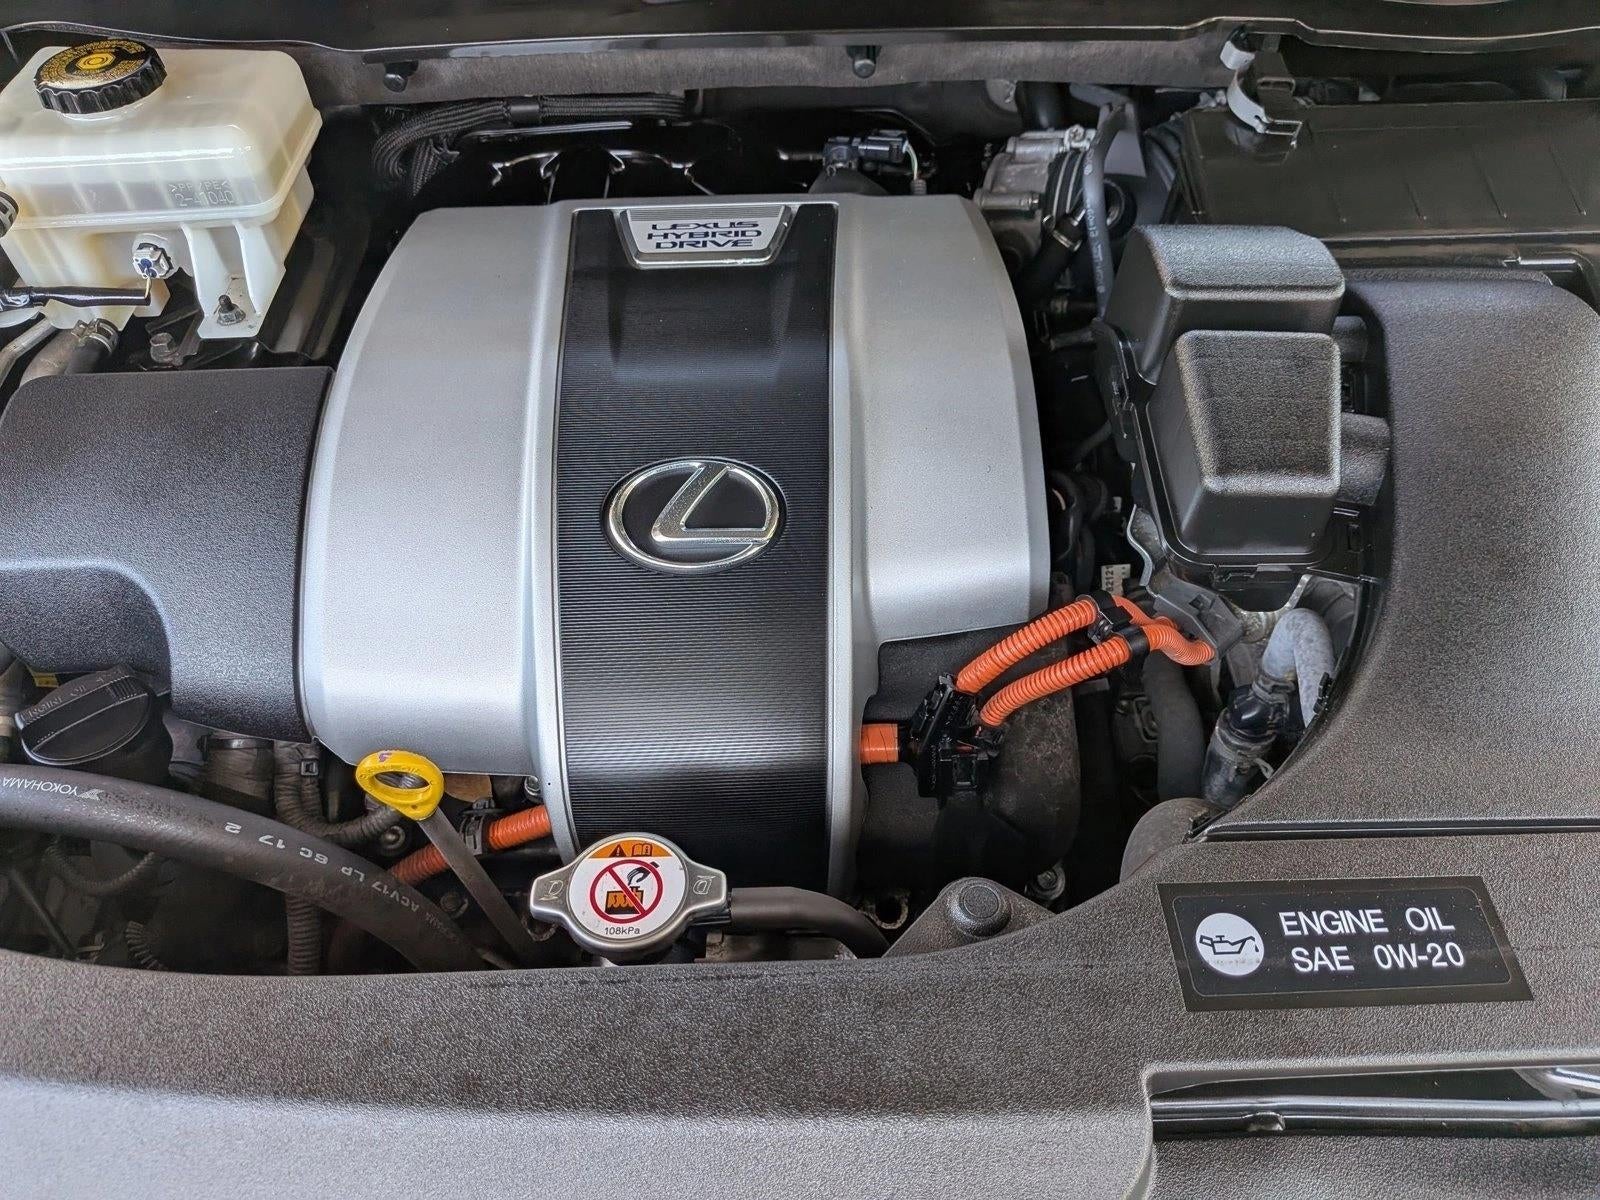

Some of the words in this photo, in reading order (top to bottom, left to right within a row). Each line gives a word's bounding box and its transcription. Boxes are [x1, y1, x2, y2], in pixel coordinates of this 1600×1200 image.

[652, 221, 759, 230] LEXUS
[647, 230, 762, 240] HYBRID
[655, 239, 753, 249] DRIVE
[2, 777, 79, 796] YOKOHAMA
[225, 822, 242, 834] 2
[259, 834, 286, 849] 17
[341, 866, 365, 882] LP
[372, 881, 420, 912] ACV17
[1278, 909, 1389, 936] ENGINE
[1405, 906, 1456, 932] OIL
[605, 926, 640, 935] 108kPa
[1291, 946, 1355, 972] SAE
[1373, 942, 1464, 969] 0W-20
